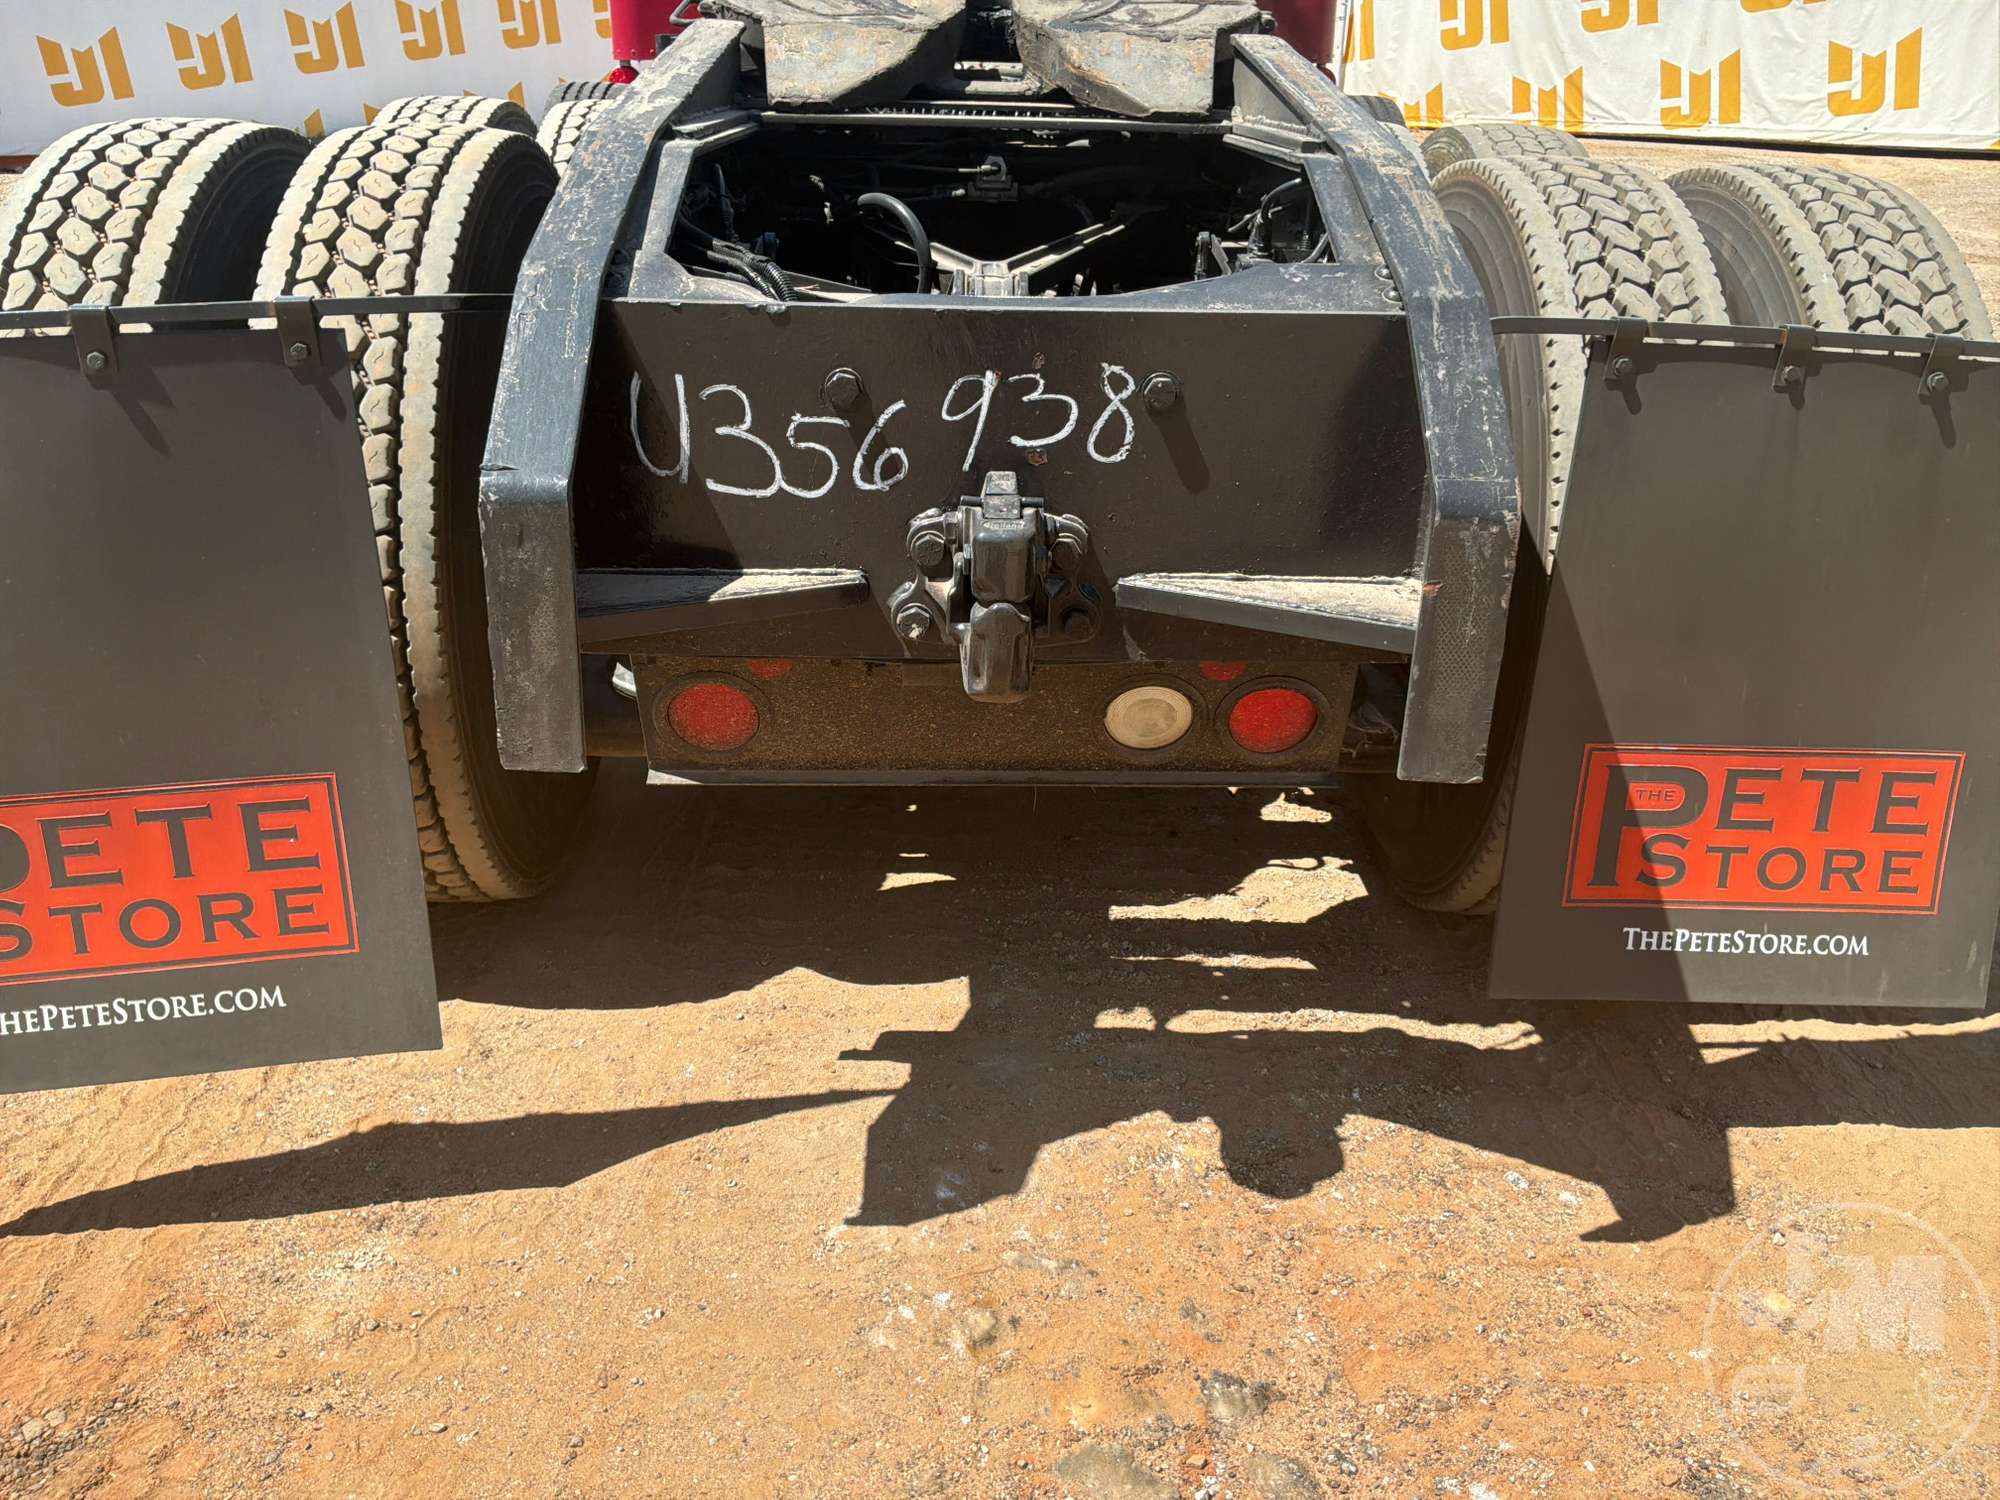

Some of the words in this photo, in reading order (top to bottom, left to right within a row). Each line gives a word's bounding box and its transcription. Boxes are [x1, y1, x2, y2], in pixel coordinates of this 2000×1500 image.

[1587, 763, 1938, 887] PETE
[1635, 788, 1677, 802] THE
[0, 795, 321, 894] ETE
[1637, 833, 1924, 896] STORE
